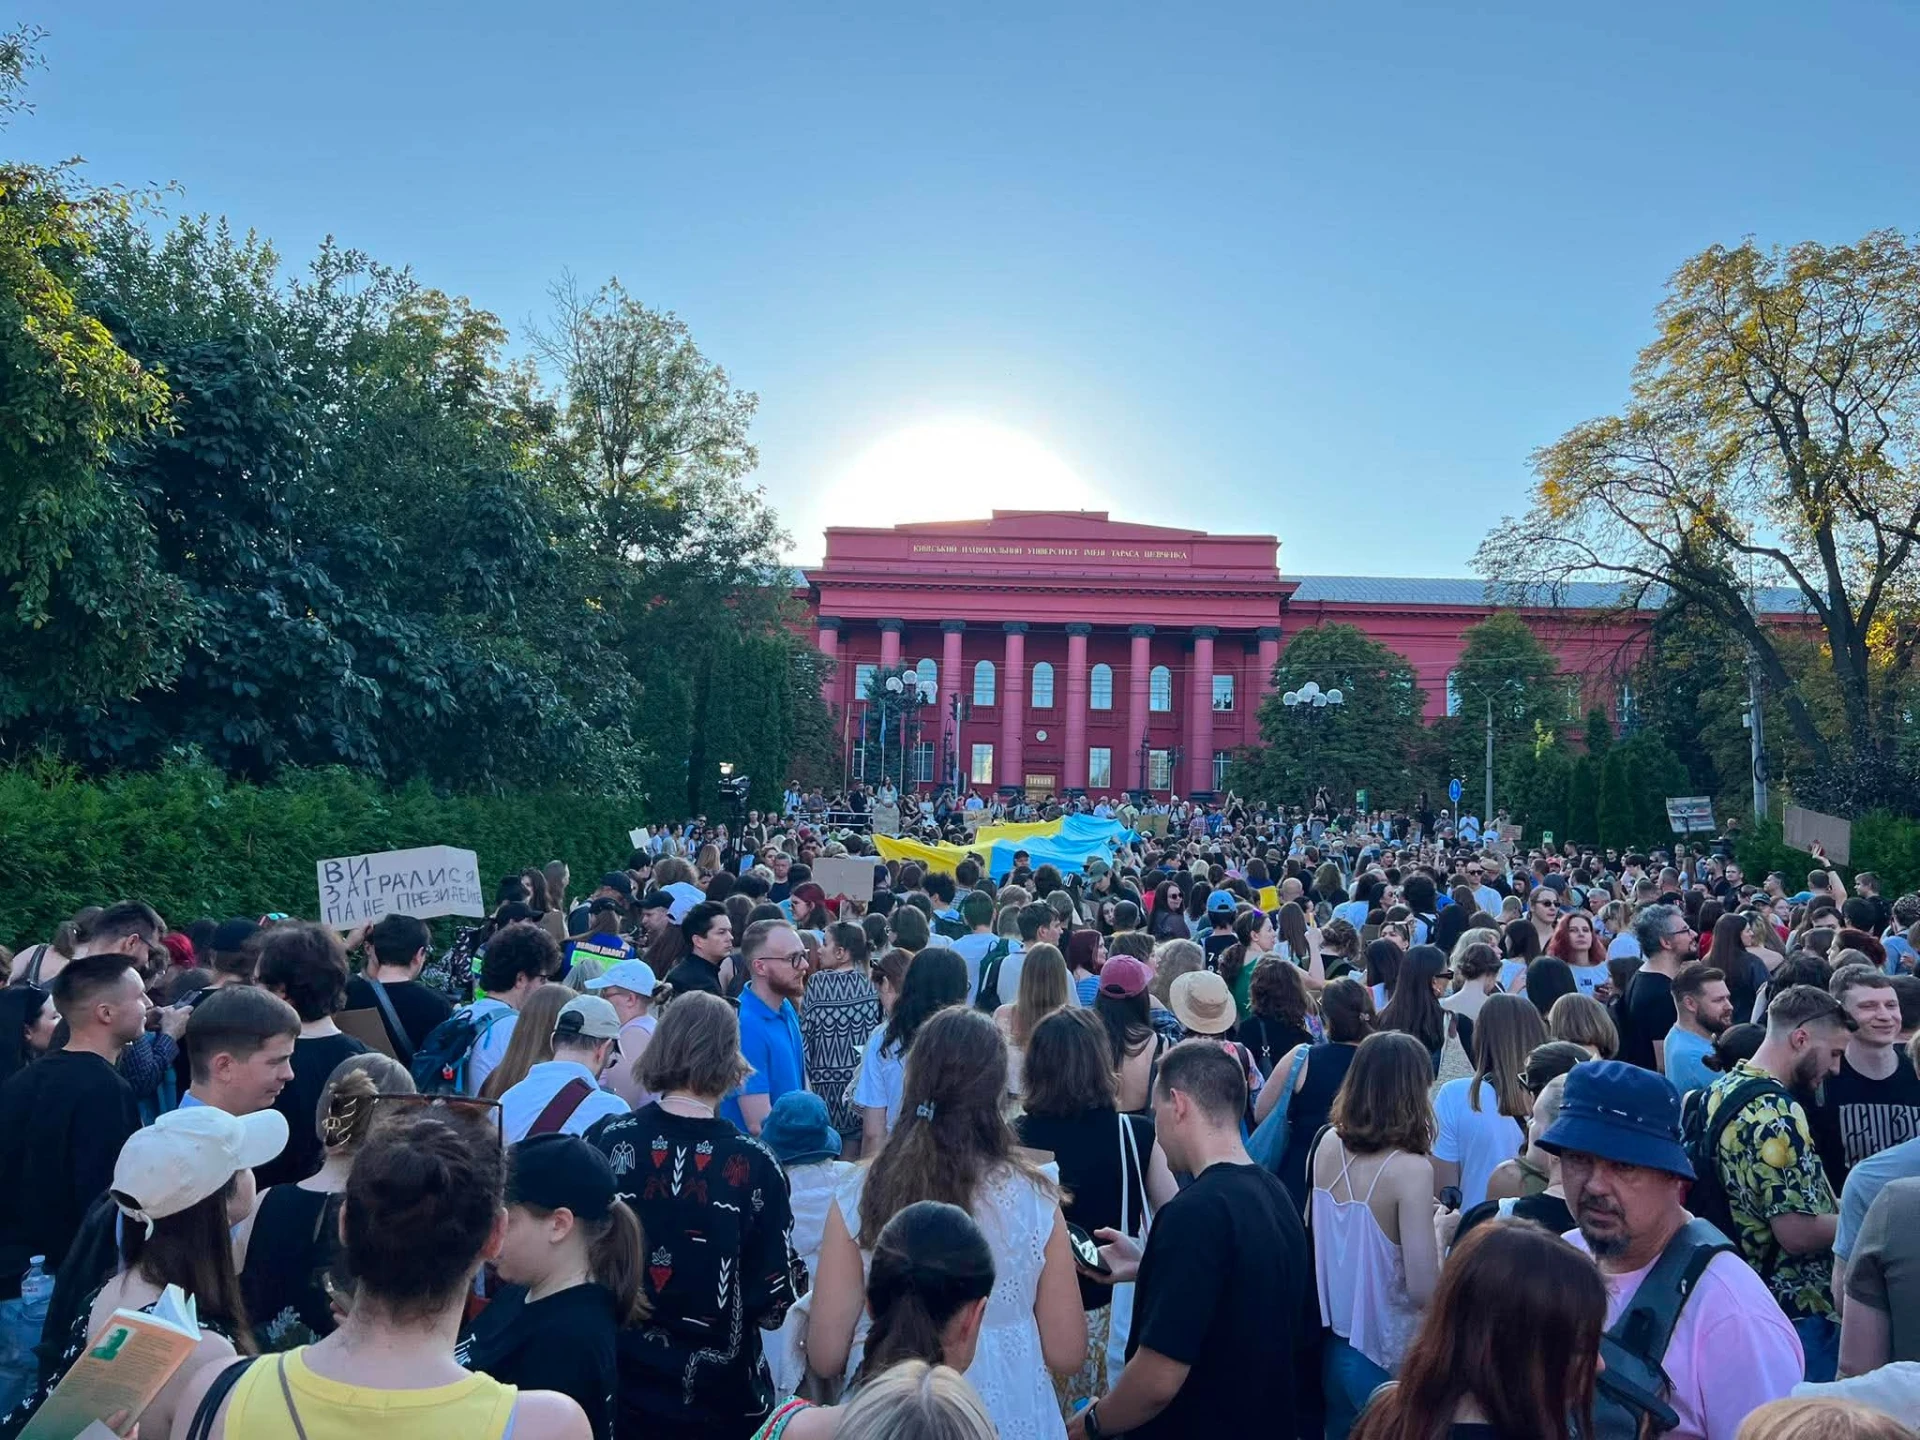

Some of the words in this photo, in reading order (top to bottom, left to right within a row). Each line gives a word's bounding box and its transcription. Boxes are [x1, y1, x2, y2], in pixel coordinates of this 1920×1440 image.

[1111, 549, 1140, 557] ТАРАСА
[324, 856, 371, 884] ВИ
[323, 867, 475, 905] ЗАГРАЛИСЯ
